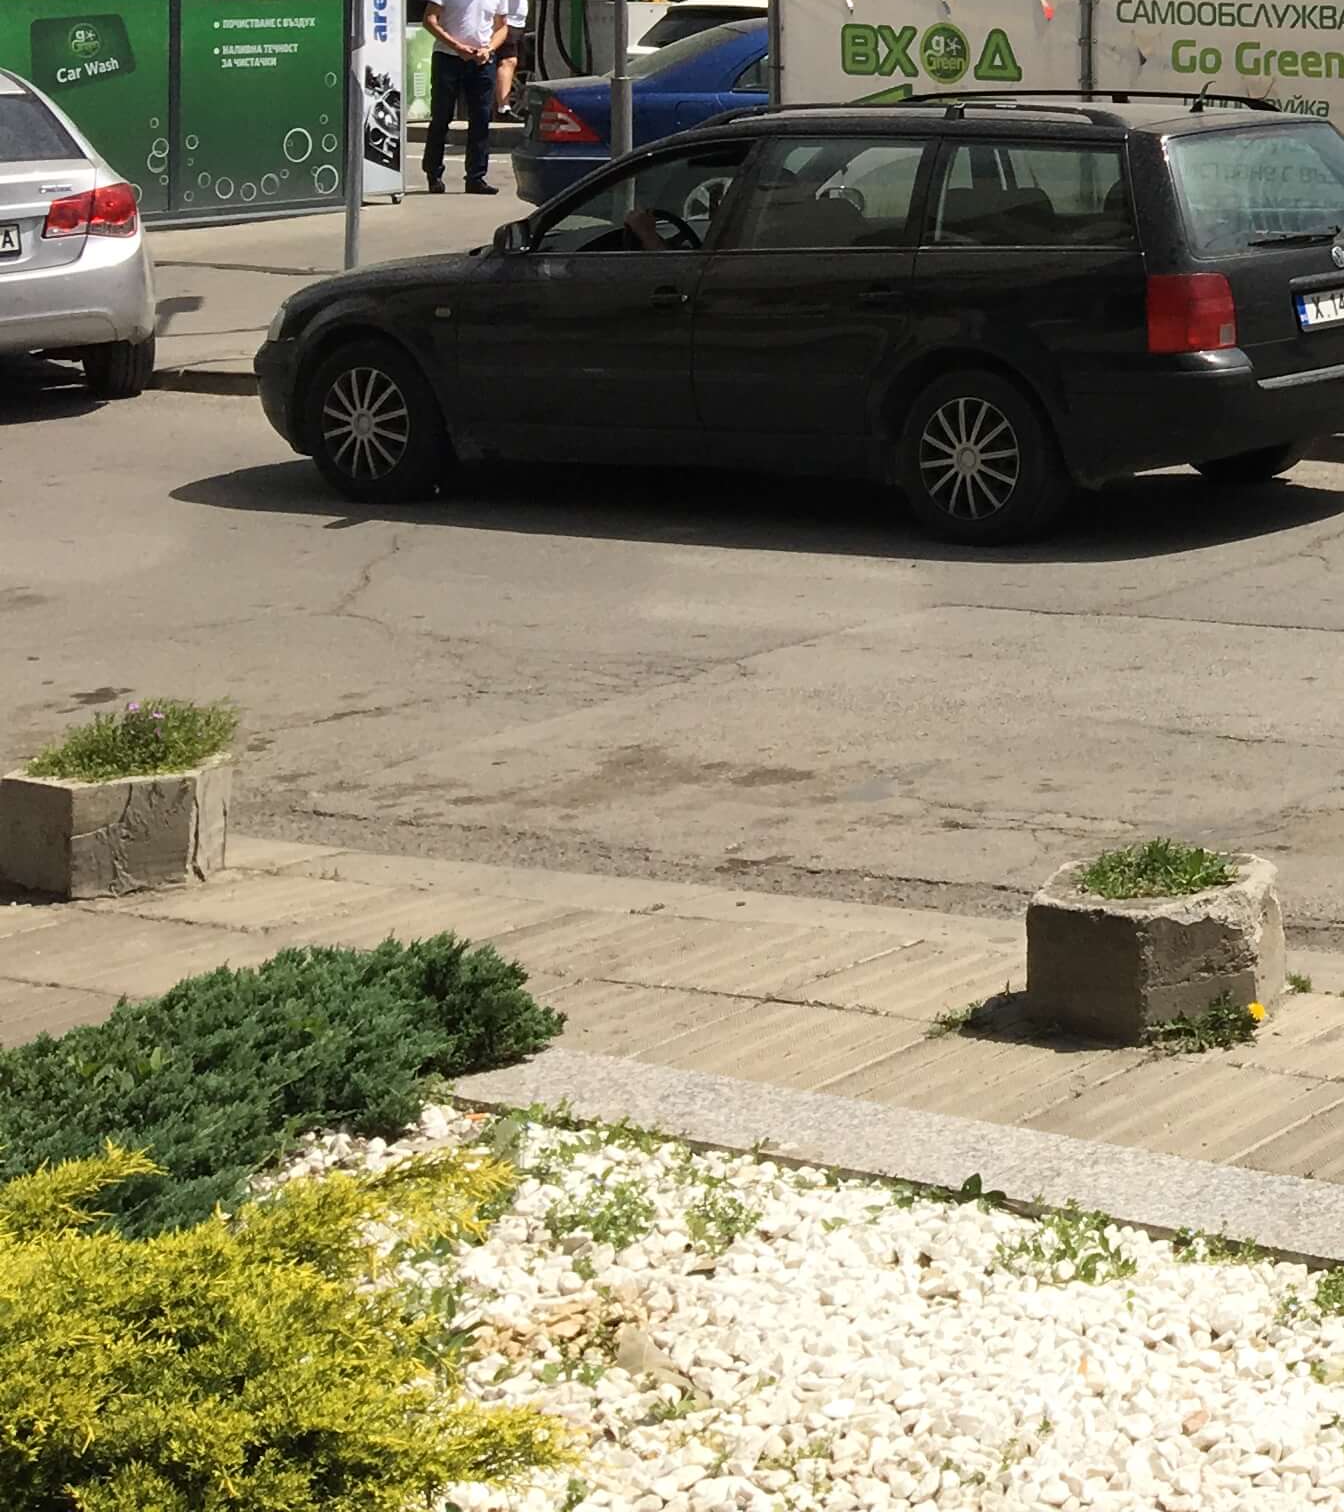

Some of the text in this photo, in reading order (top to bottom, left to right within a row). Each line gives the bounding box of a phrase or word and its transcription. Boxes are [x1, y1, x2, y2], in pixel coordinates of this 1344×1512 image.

[223, 17, 315, 29] ПОЧИСТВАНЕ С ВЪЗДУХ
[264, 43, 298, 54] ТЕЧНОСТ
[221, 57, 276, 68] ЗА ЧИСТАЧКИ
[1171, 39, 1222, 74] Go
[57, 57, 119, 83] Car Wash
